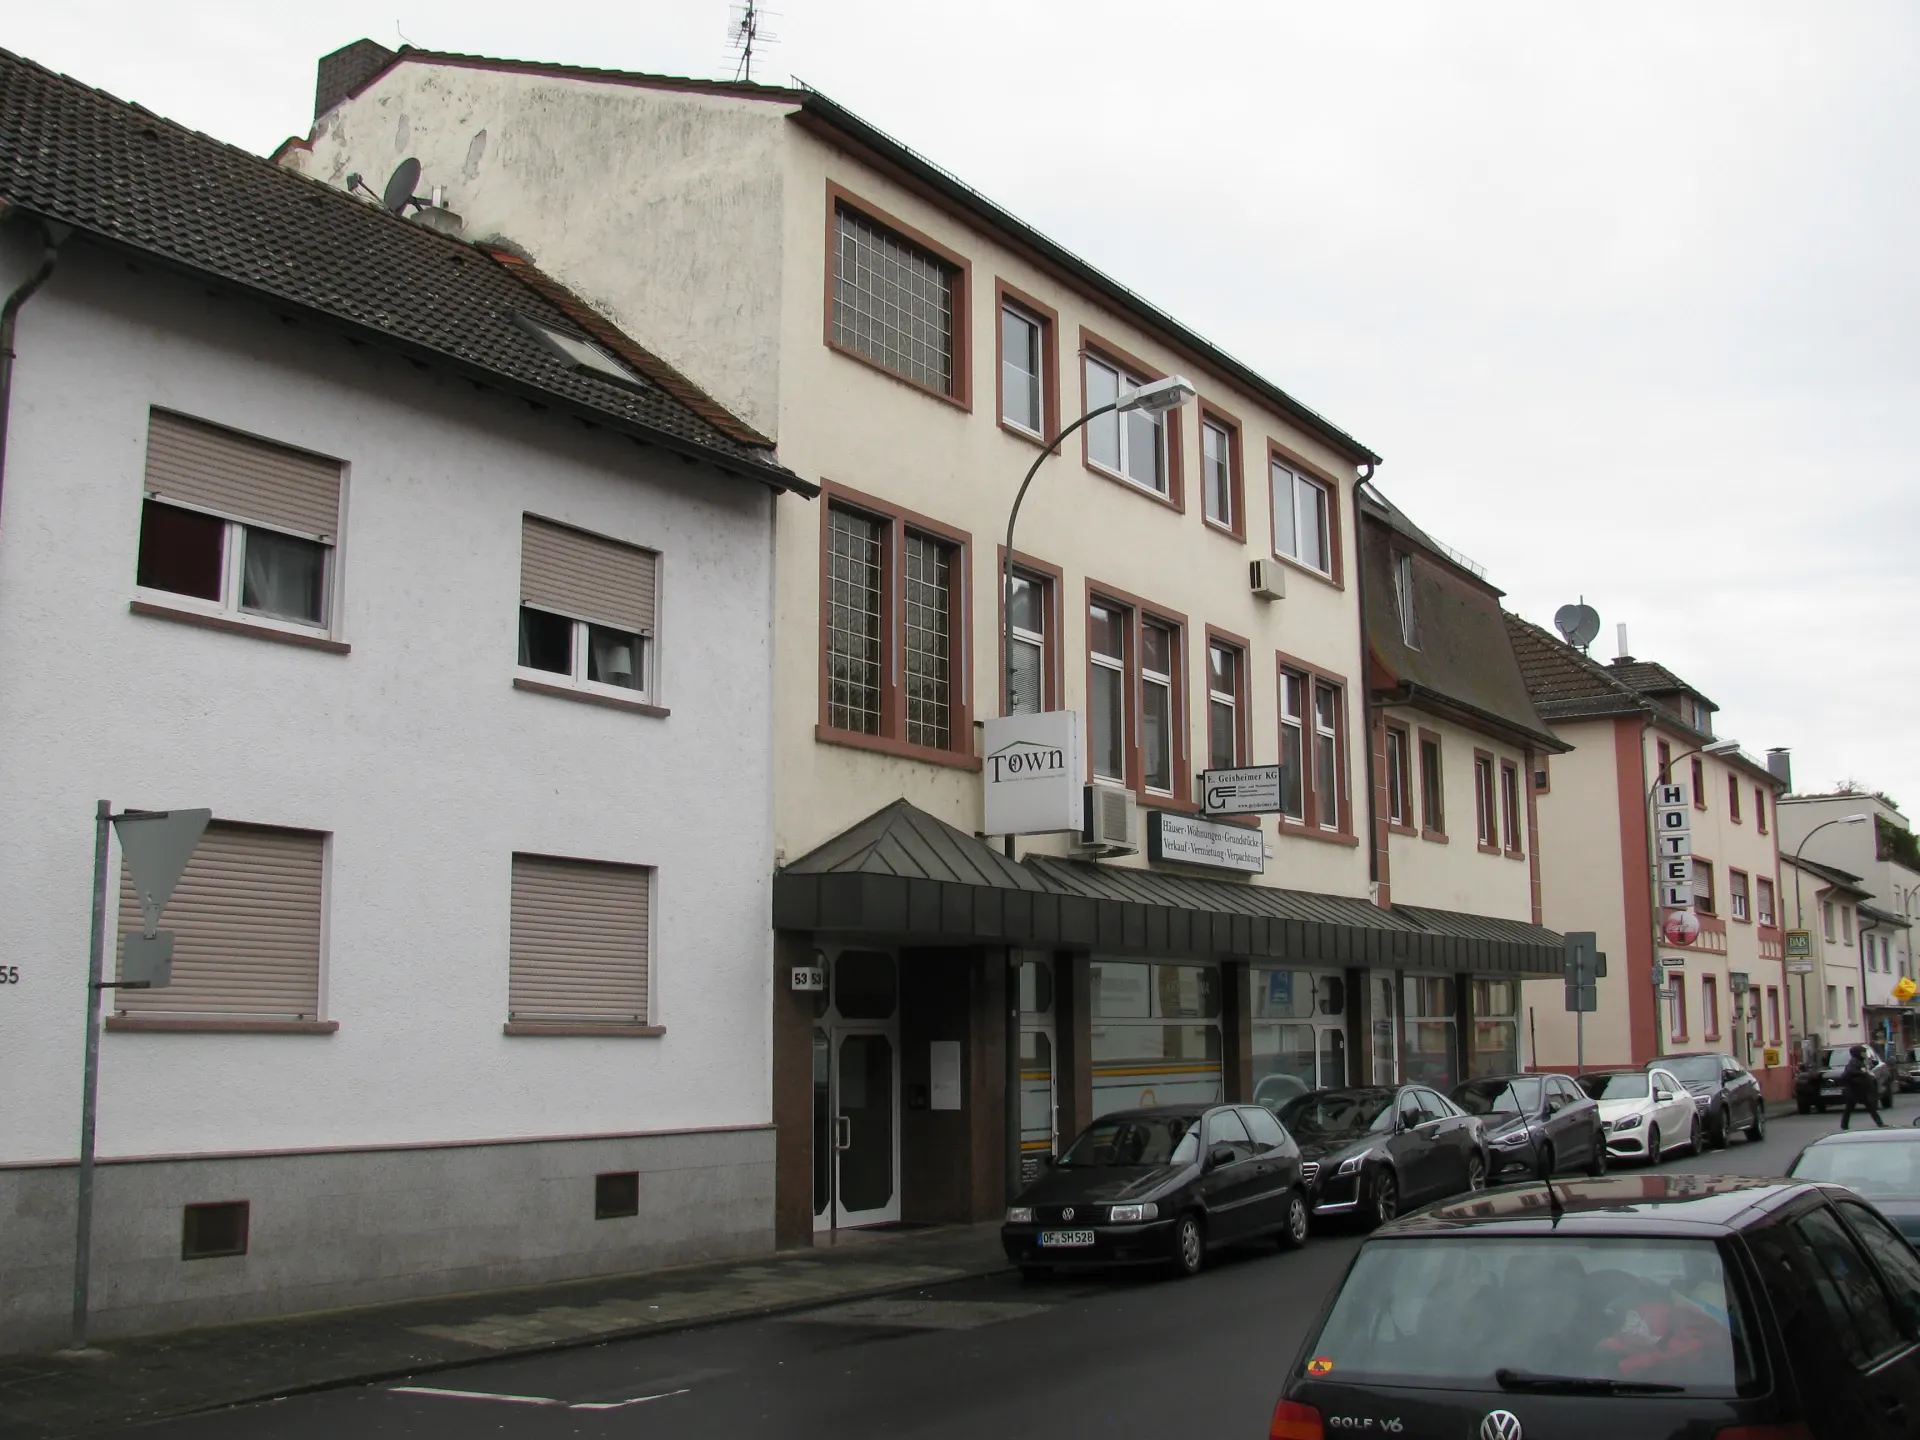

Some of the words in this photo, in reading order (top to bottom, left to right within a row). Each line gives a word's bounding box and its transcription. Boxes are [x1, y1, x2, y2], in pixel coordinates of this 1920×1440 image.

[987, 749, 1065, 783] Town
[1218, 773, 1262, 782] Geisheimer
[1265, 771, 1277, 780] KG
[1163, 820, 1184, 834] Häuser
[1187, 825, 1222, 844] Wohnungen
[1224, 832, 1259, 847] Grundstücke
[1163, 838, 1188, 852] Verkauf
[1190, 843, 1224, 862] Vermietung
[1227, 849, 1261, 868] Verpachtung
[1664, 786, 1687, 904] HOTEL
[794, 972, 807, 984] 53
[1043, 1232, 1054, 1243] OF
[1329, 1416, 1373, 1429] GOLF
[1379, 1416, 1404, 1432] V6
